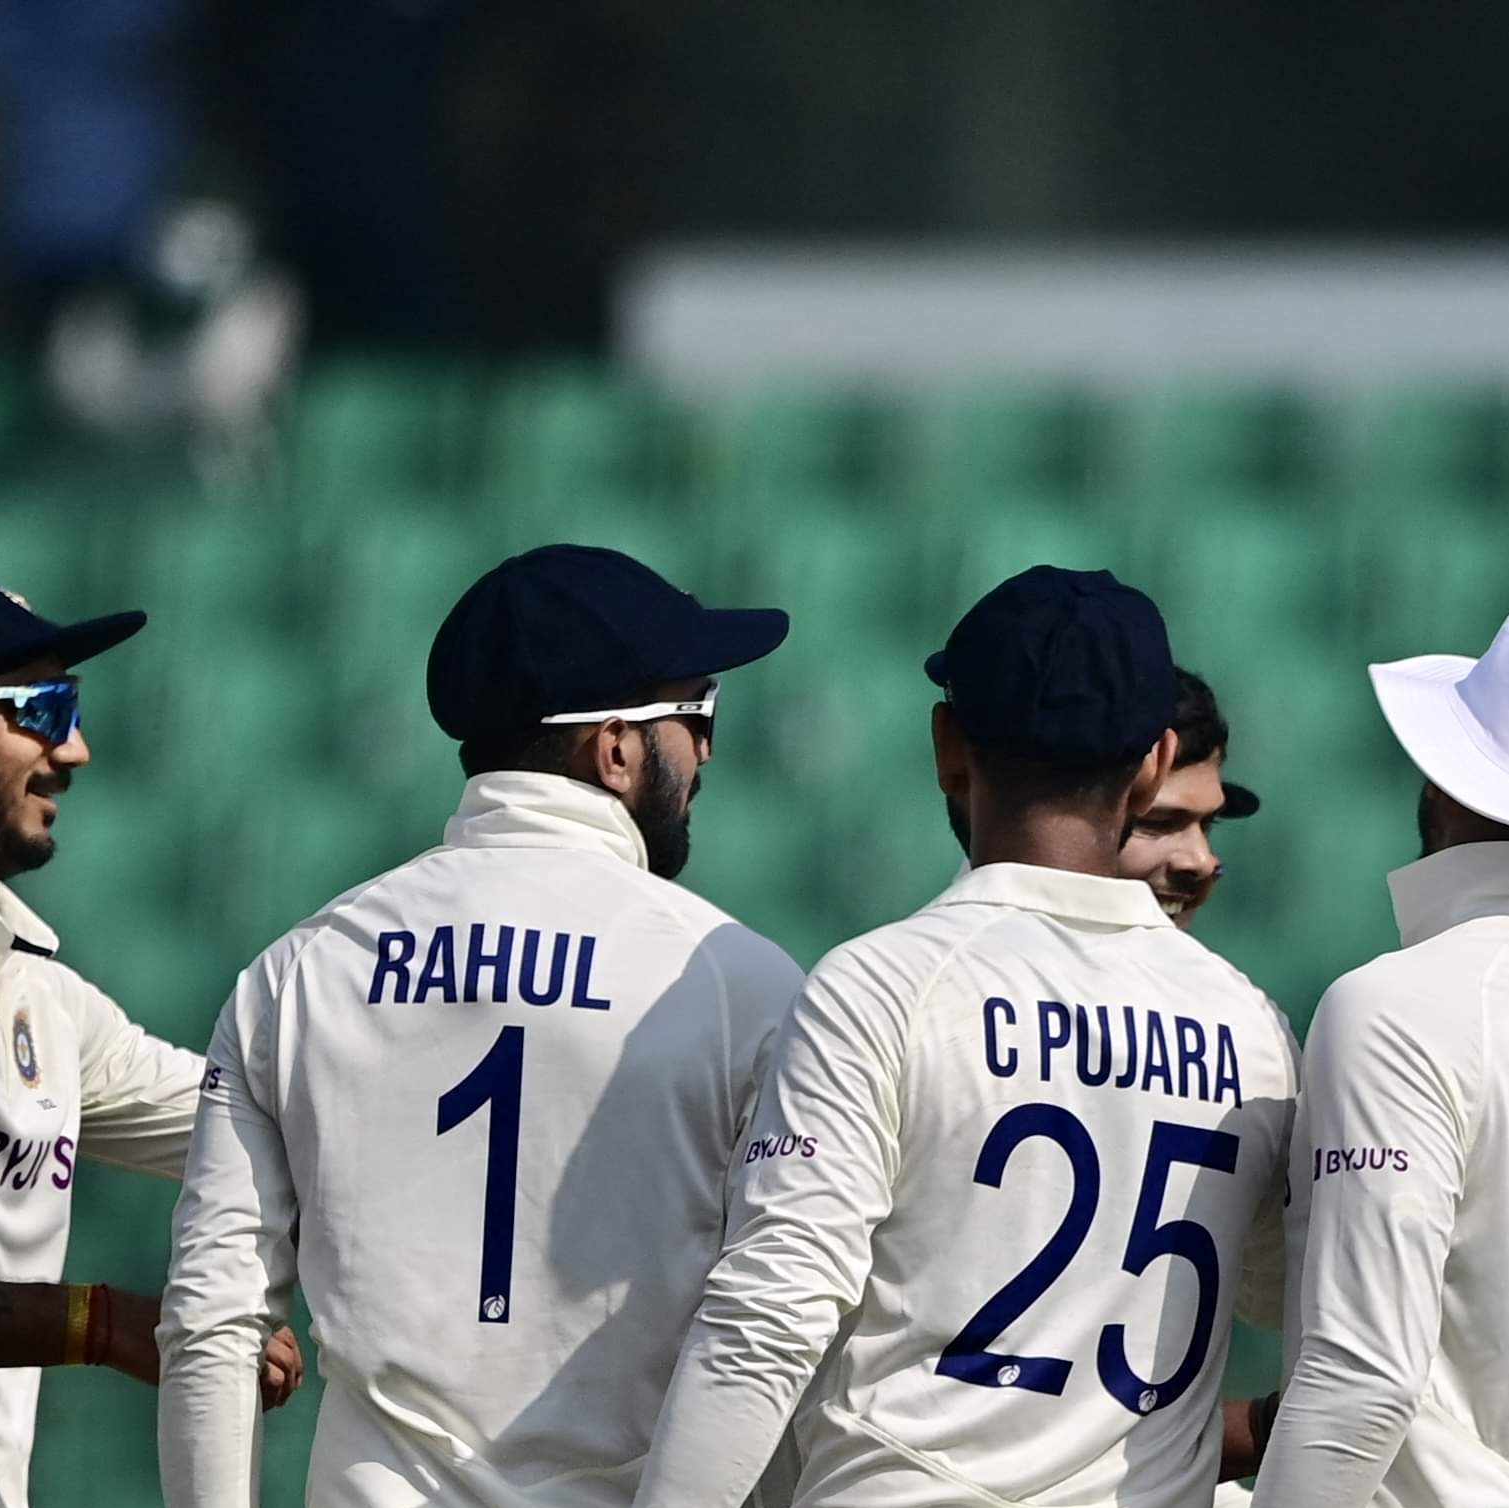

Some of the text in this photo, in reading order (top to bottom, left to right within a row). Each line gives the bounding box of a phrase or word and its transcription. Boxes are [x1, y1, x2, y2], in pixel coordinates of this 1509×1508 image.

[367, 922, 612, 1011] RAHUL
[982, 997, 1244, 1110] C PUJARA
[436, 1025, 525, 1325] 1
[745, 1134, 818, 1164] BYJU'S
[1326, 1146, 1409, 1175] BYJU'S
[934, 1102, 1241, 1417] 25
